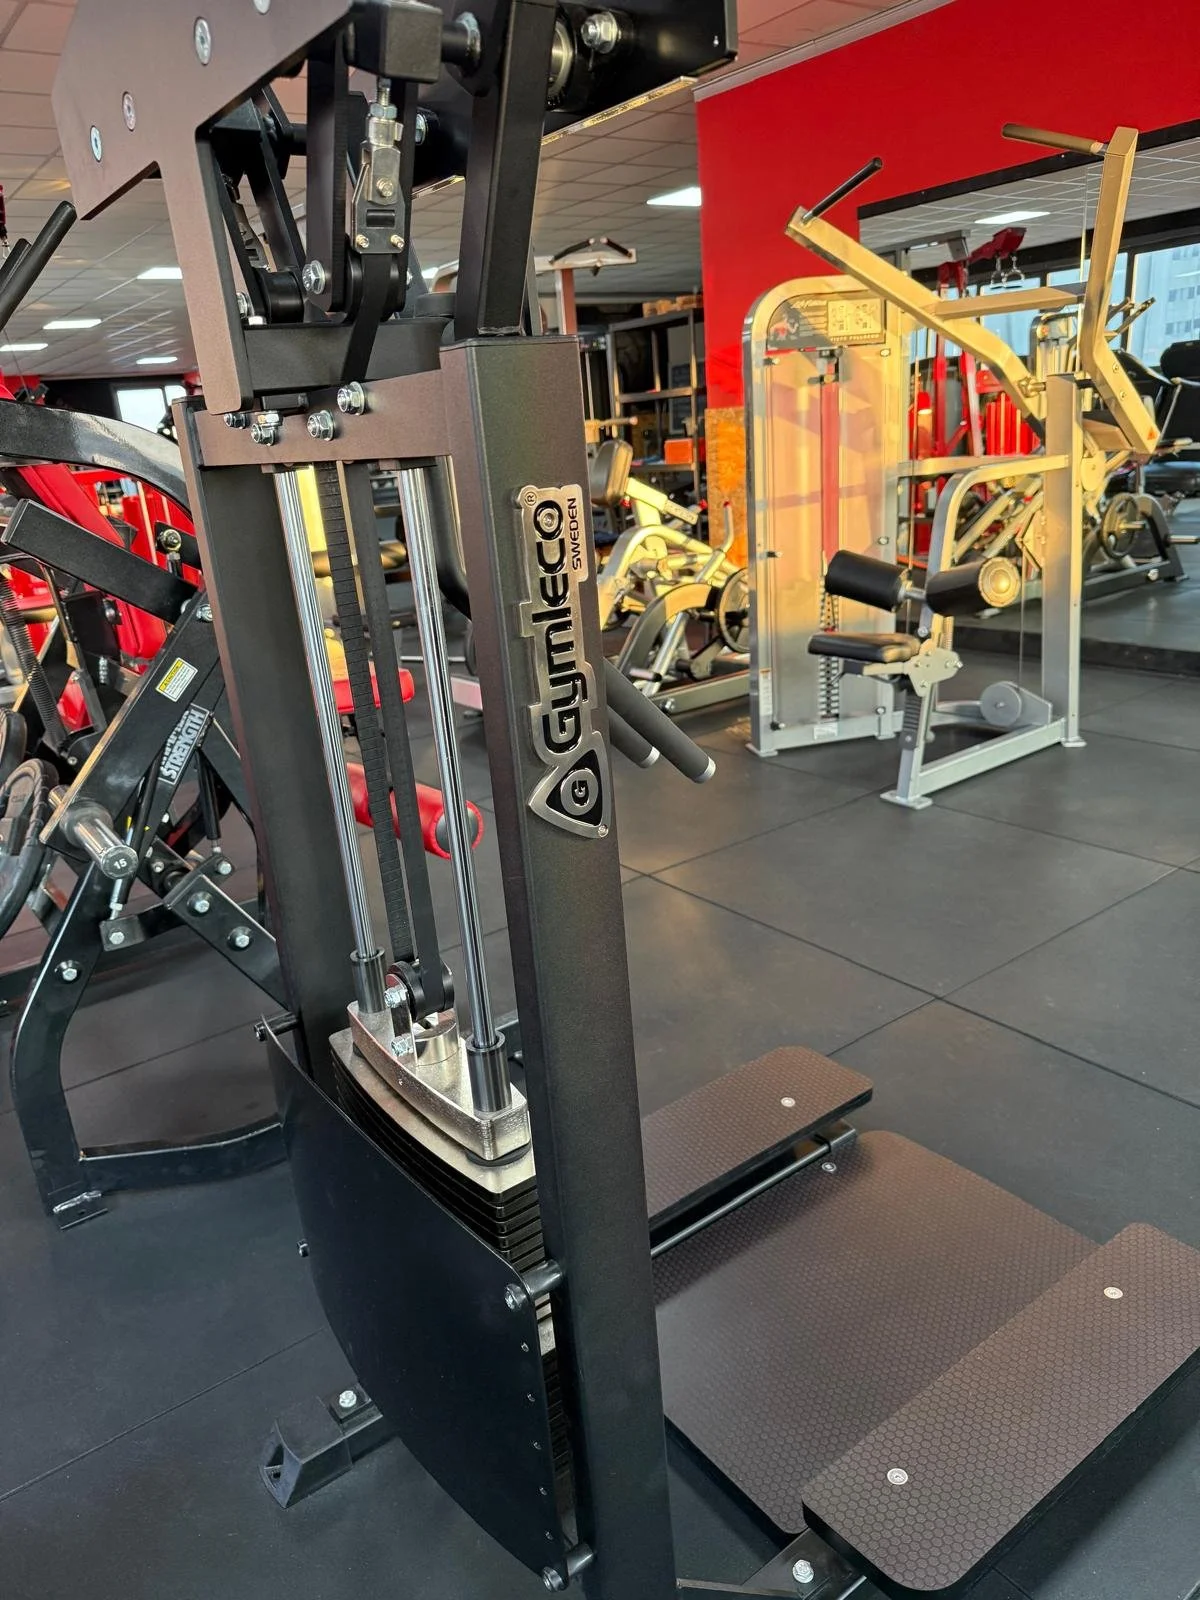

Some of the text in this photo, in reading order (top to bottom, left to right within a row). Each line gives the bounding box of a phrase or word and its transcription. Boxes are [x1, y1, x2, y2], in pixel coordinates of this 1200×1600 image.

[567, 498, 582, 570] SWEDEN
[160, 709, 206, 780] STRENGTH
[113, 858, 128, 870] 15
